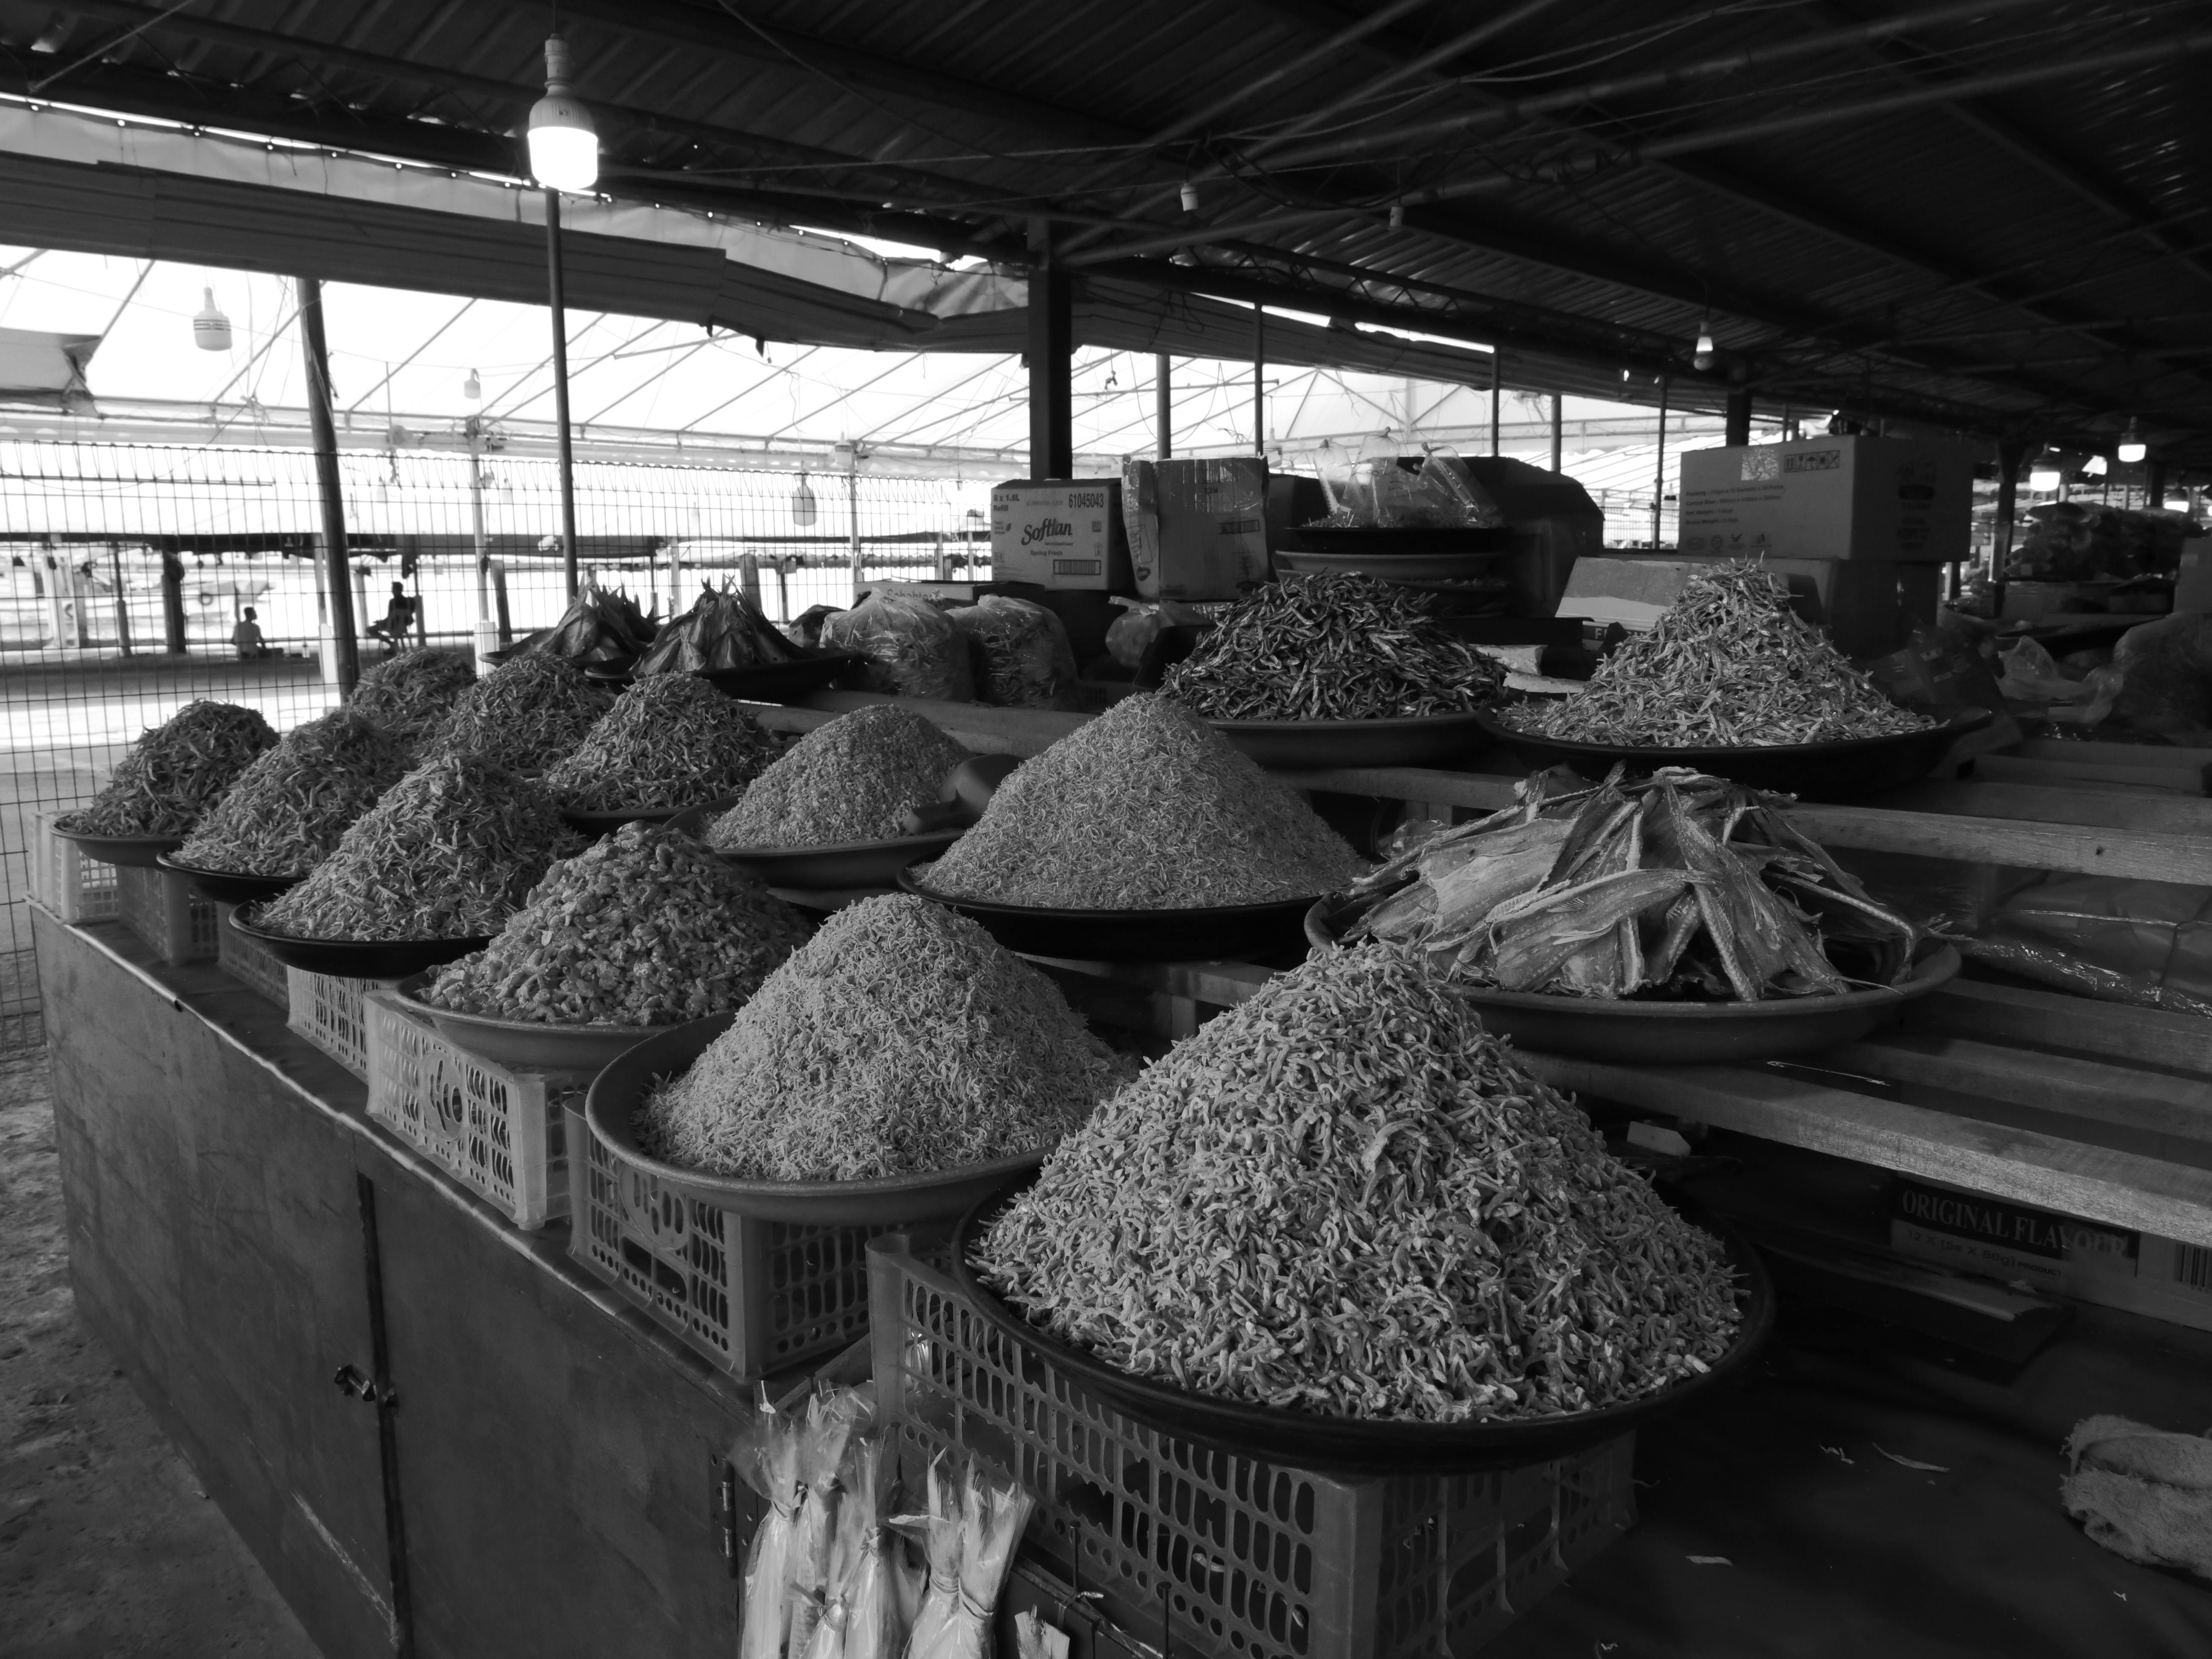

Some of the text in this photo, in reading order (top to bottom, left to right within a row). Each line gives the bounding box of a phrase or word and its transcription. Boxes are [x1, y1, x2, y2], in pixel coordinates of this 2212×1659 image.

[1069, 493, 1104, 508] 61045043
[1021, 518, 1072, 545] Softlan
[1903, 1190, 2008, 1237] ORIGINAL
[1908, 1229, 1921, 1240] 12
[1982, 1250, 2016, 1268] 80g)
